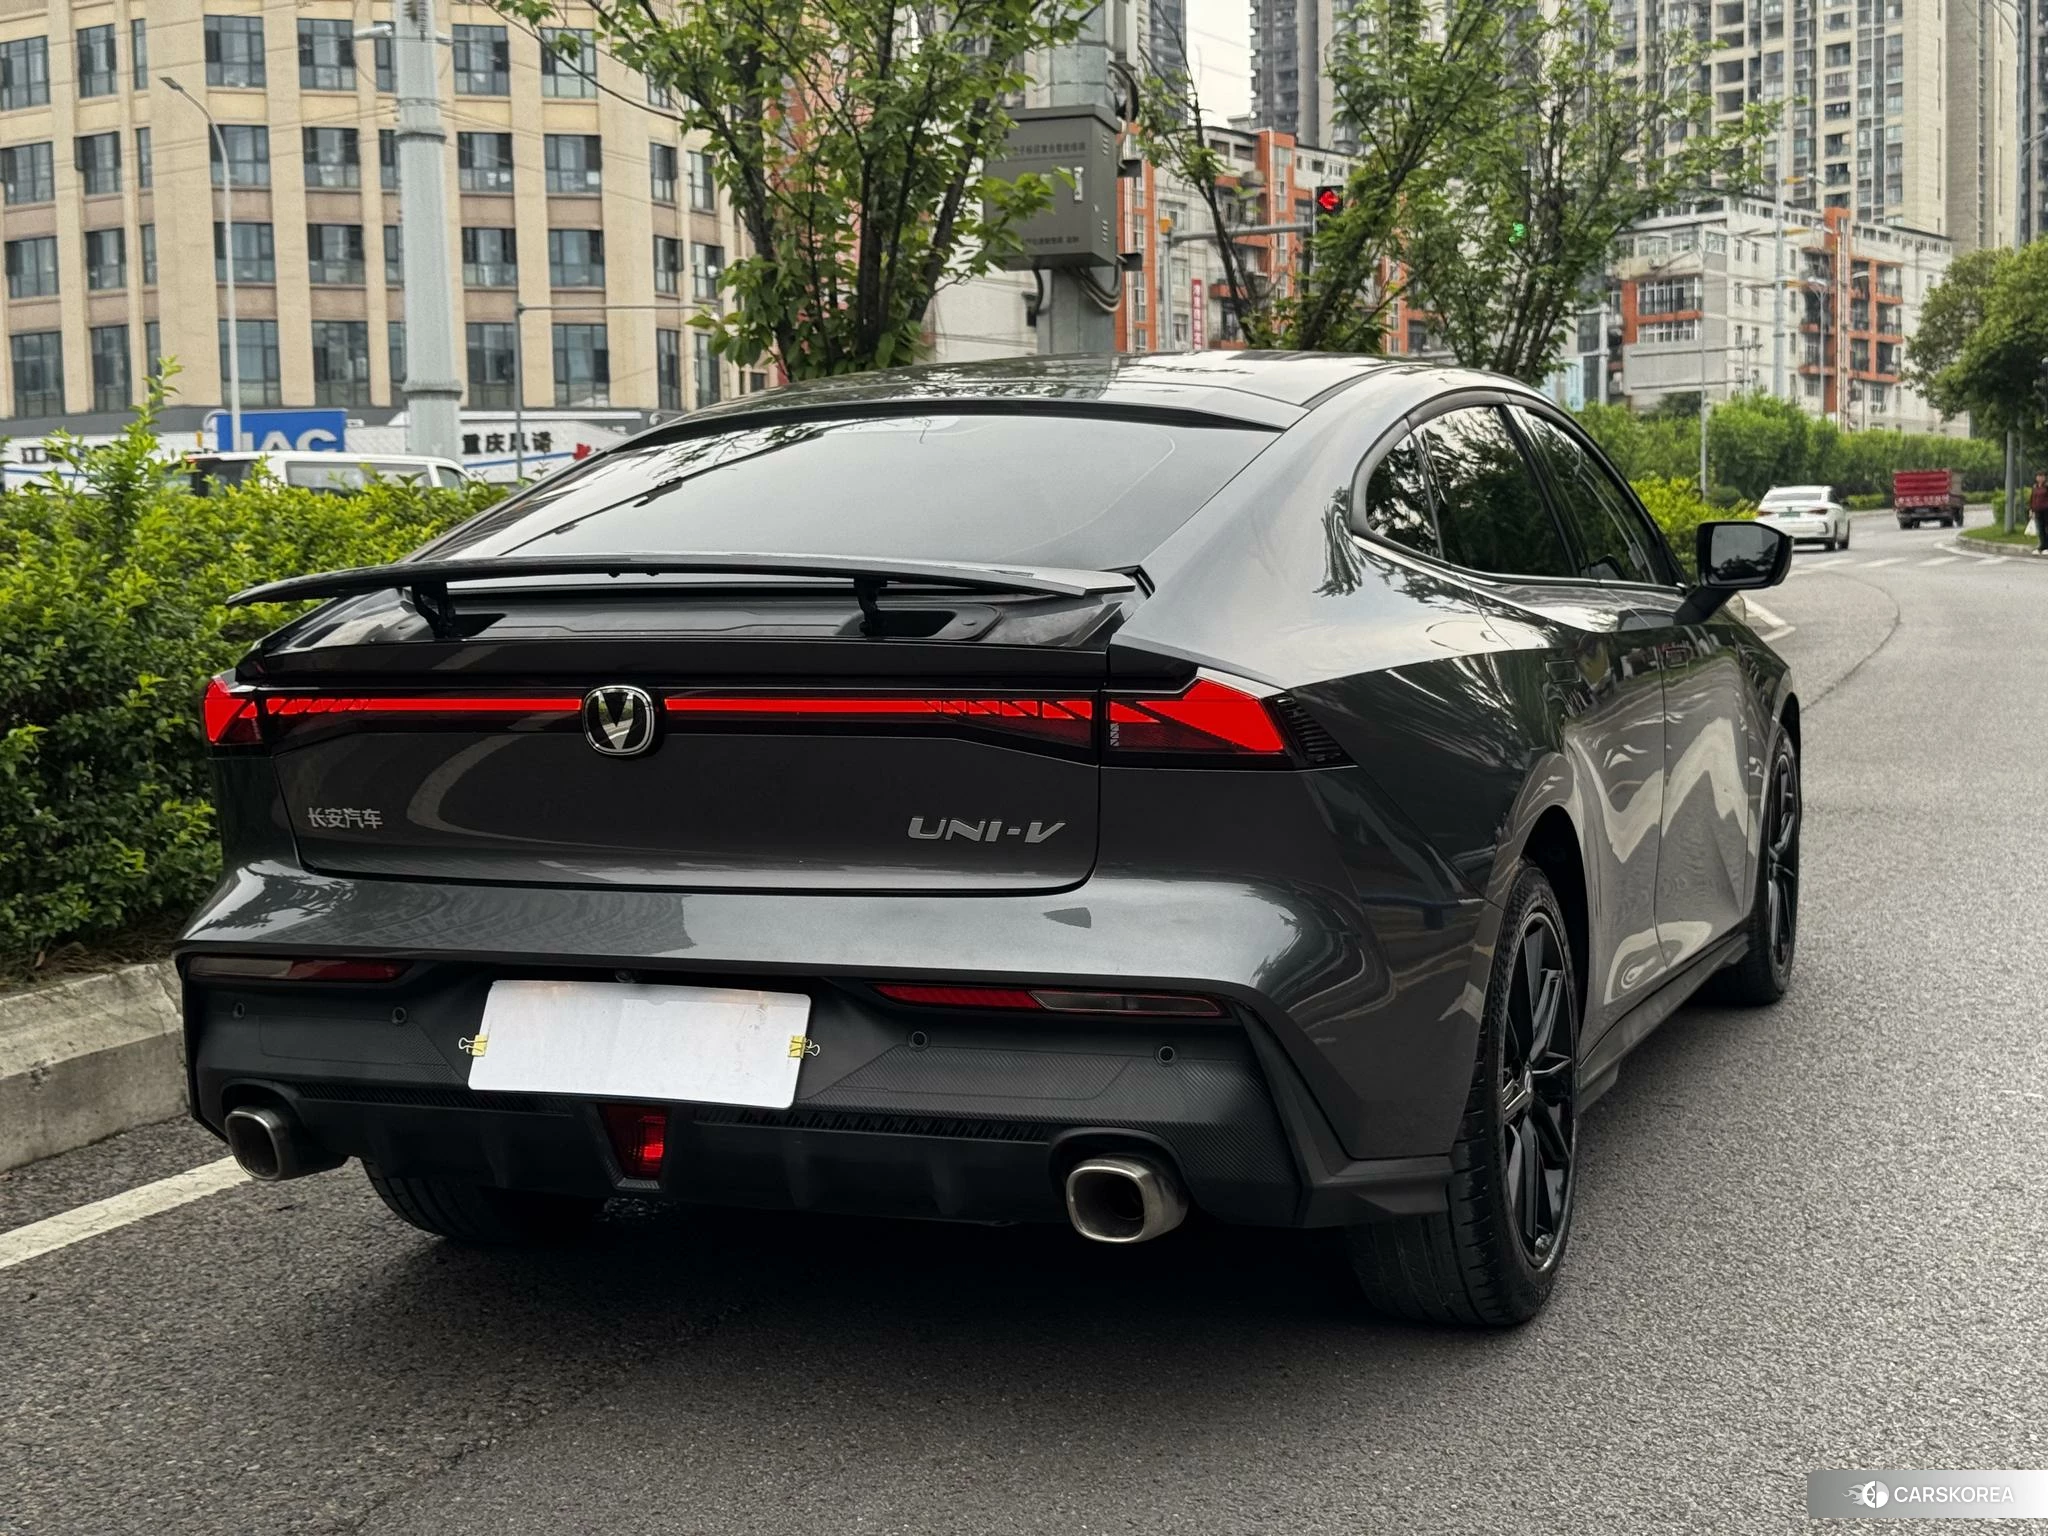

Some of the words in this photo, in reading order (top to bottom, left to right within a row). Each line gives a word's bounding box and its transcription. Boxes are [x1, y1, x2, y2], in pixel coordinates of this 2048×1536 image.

[307, 807, 383, 829] 长安汽车
[907, 817, 1067, 843] UNI-V
